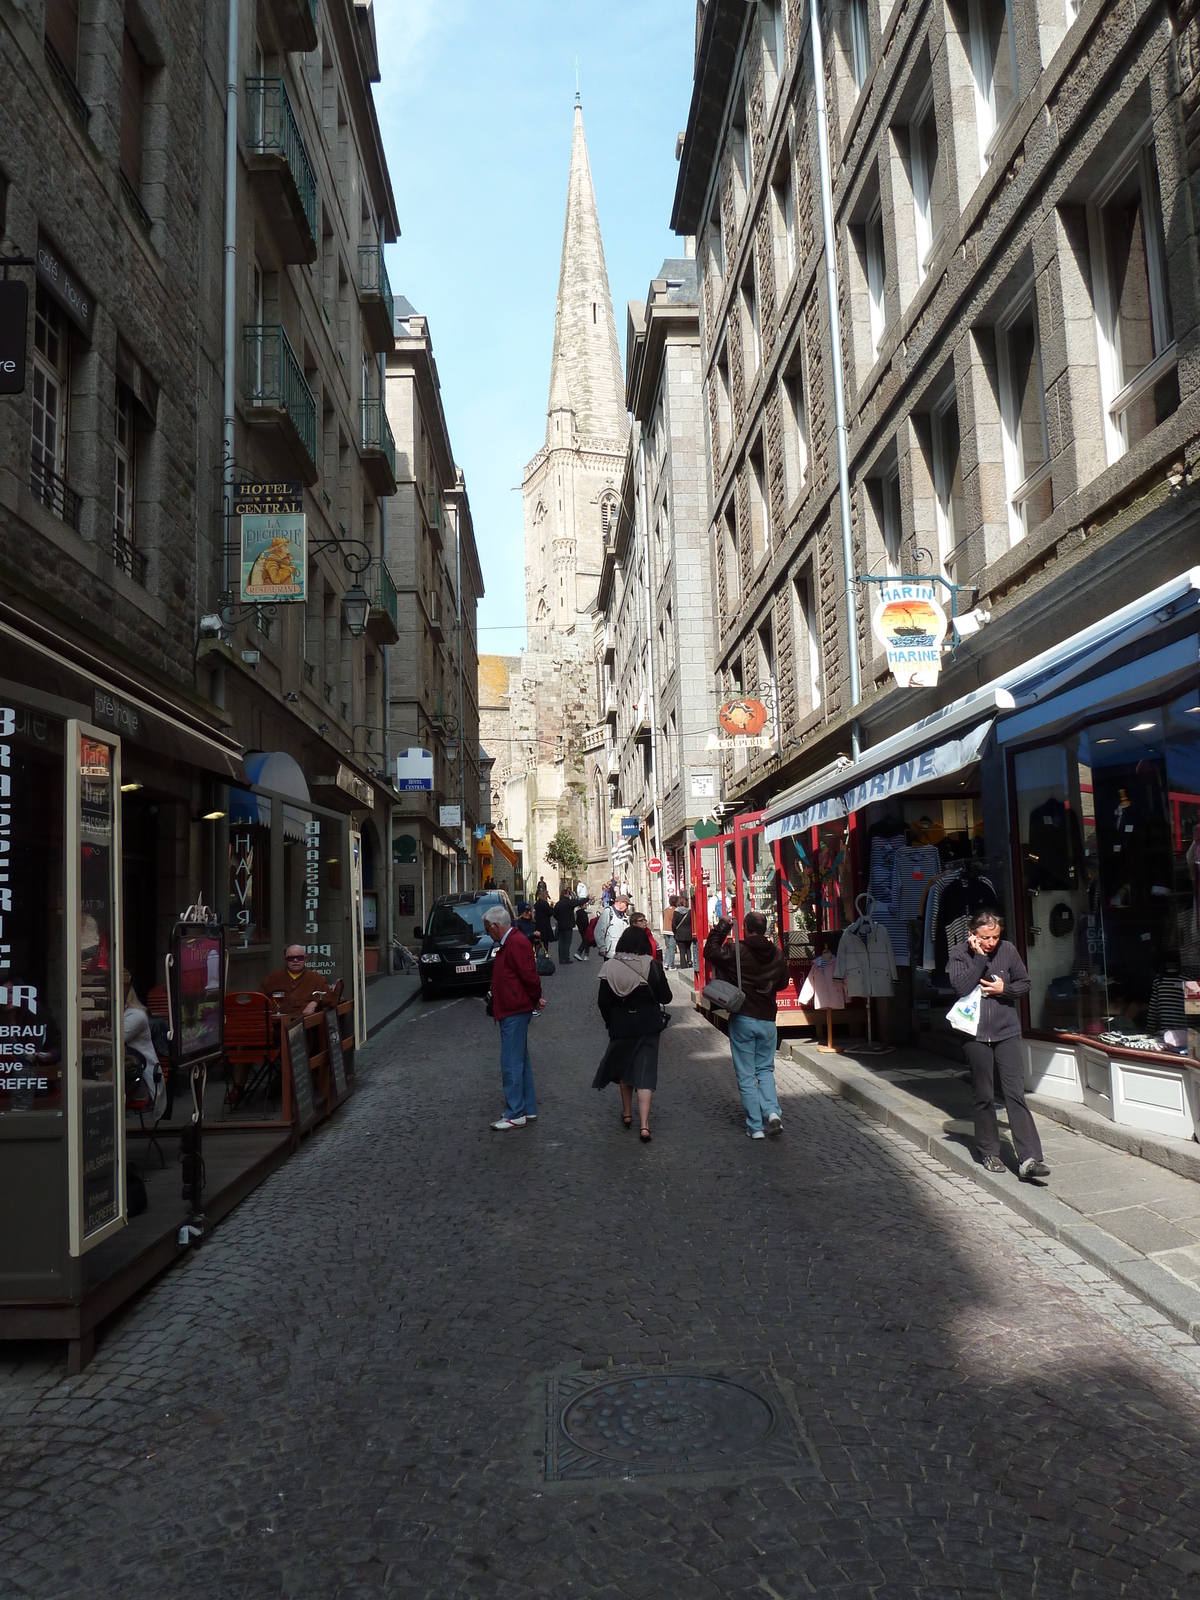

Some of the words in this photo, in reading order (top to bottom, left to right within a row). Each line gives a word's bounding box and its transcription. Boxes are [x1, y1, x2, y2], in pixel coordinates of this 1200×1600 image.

[240, 484, 292, 495] HOTEL
[235, 502, 300, 514] CENTRAL
[267, 519, 281, 528] LA
[249, 586, 297, 595] RESTAURANT
[881, 586, 933, 602] MARIN
[889, 650, 939, 662] MARINE
[843, 748, 937, 808] MARINE
[780, 803, 830, 834] MARIN
